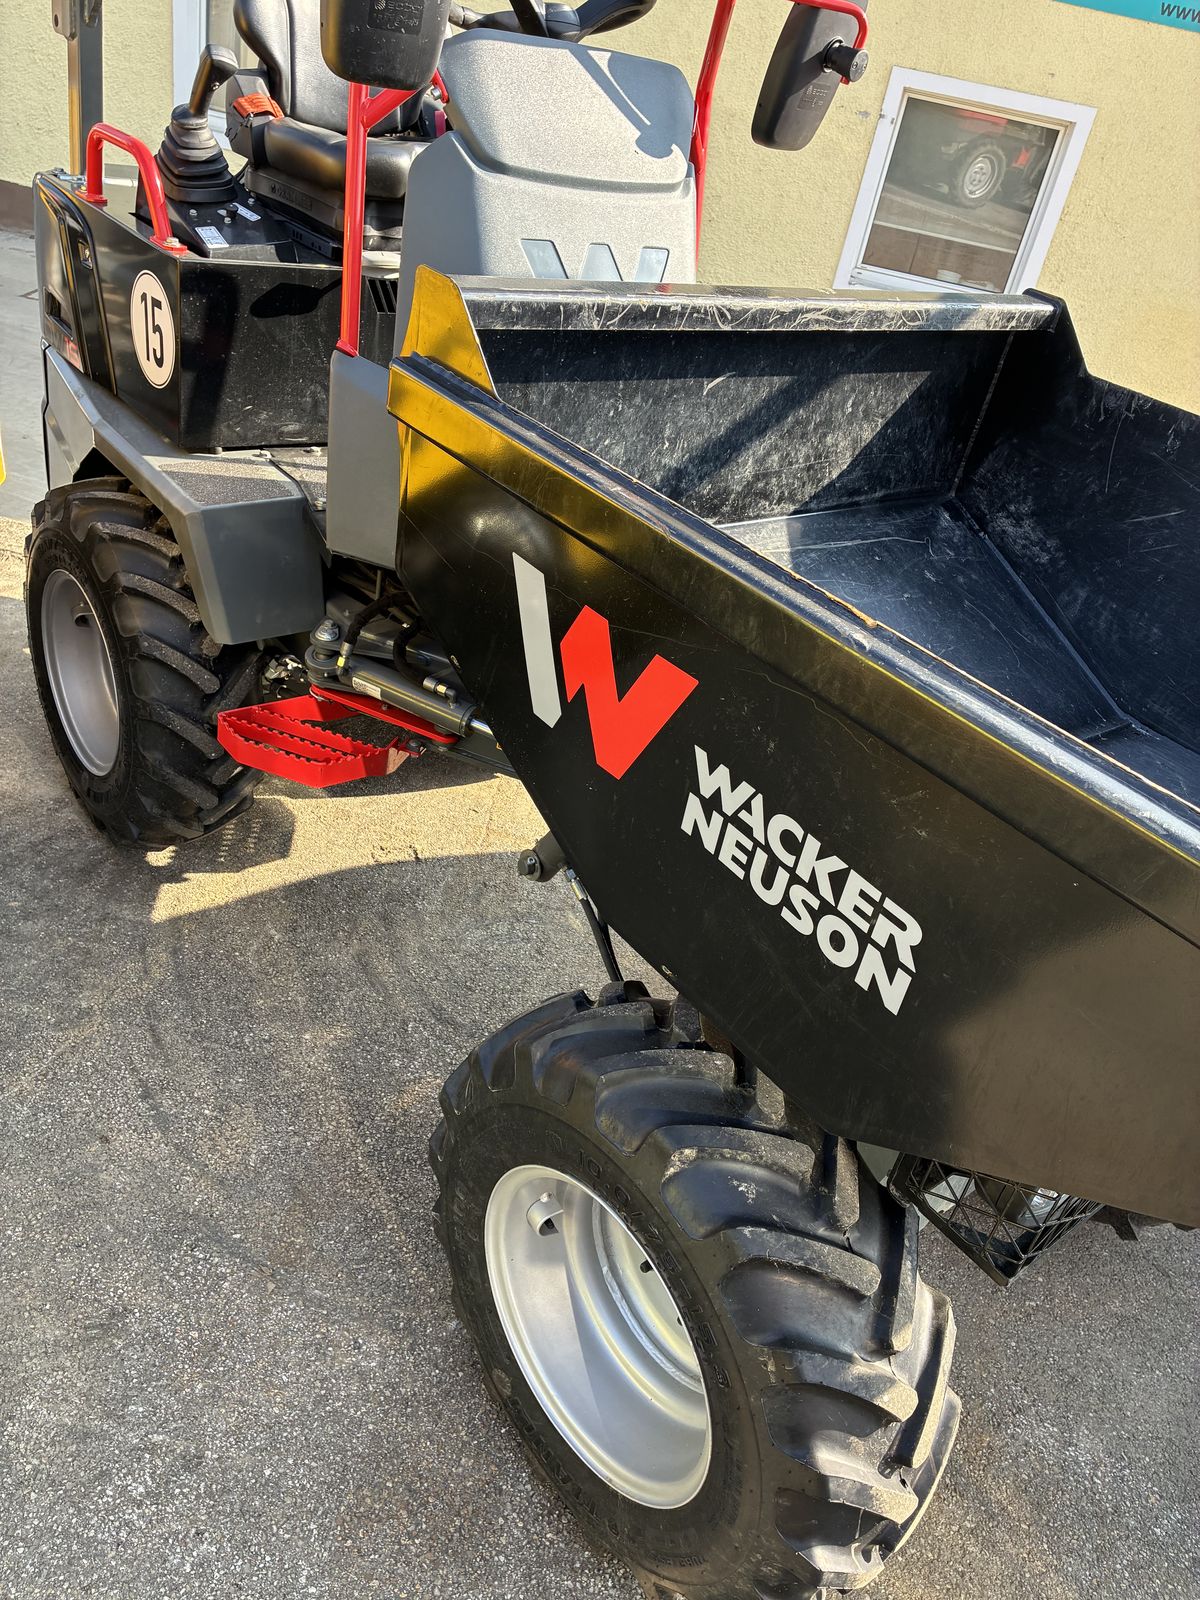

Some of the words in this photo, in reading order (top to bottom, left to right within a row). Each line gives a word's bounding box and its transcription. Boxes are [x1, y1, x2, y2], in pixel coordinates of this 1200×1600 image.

[140, 291, 165, 368] 15
[680, 791, 913, 1016] NEUSON
[694, 744, 923, 973] WACKER
